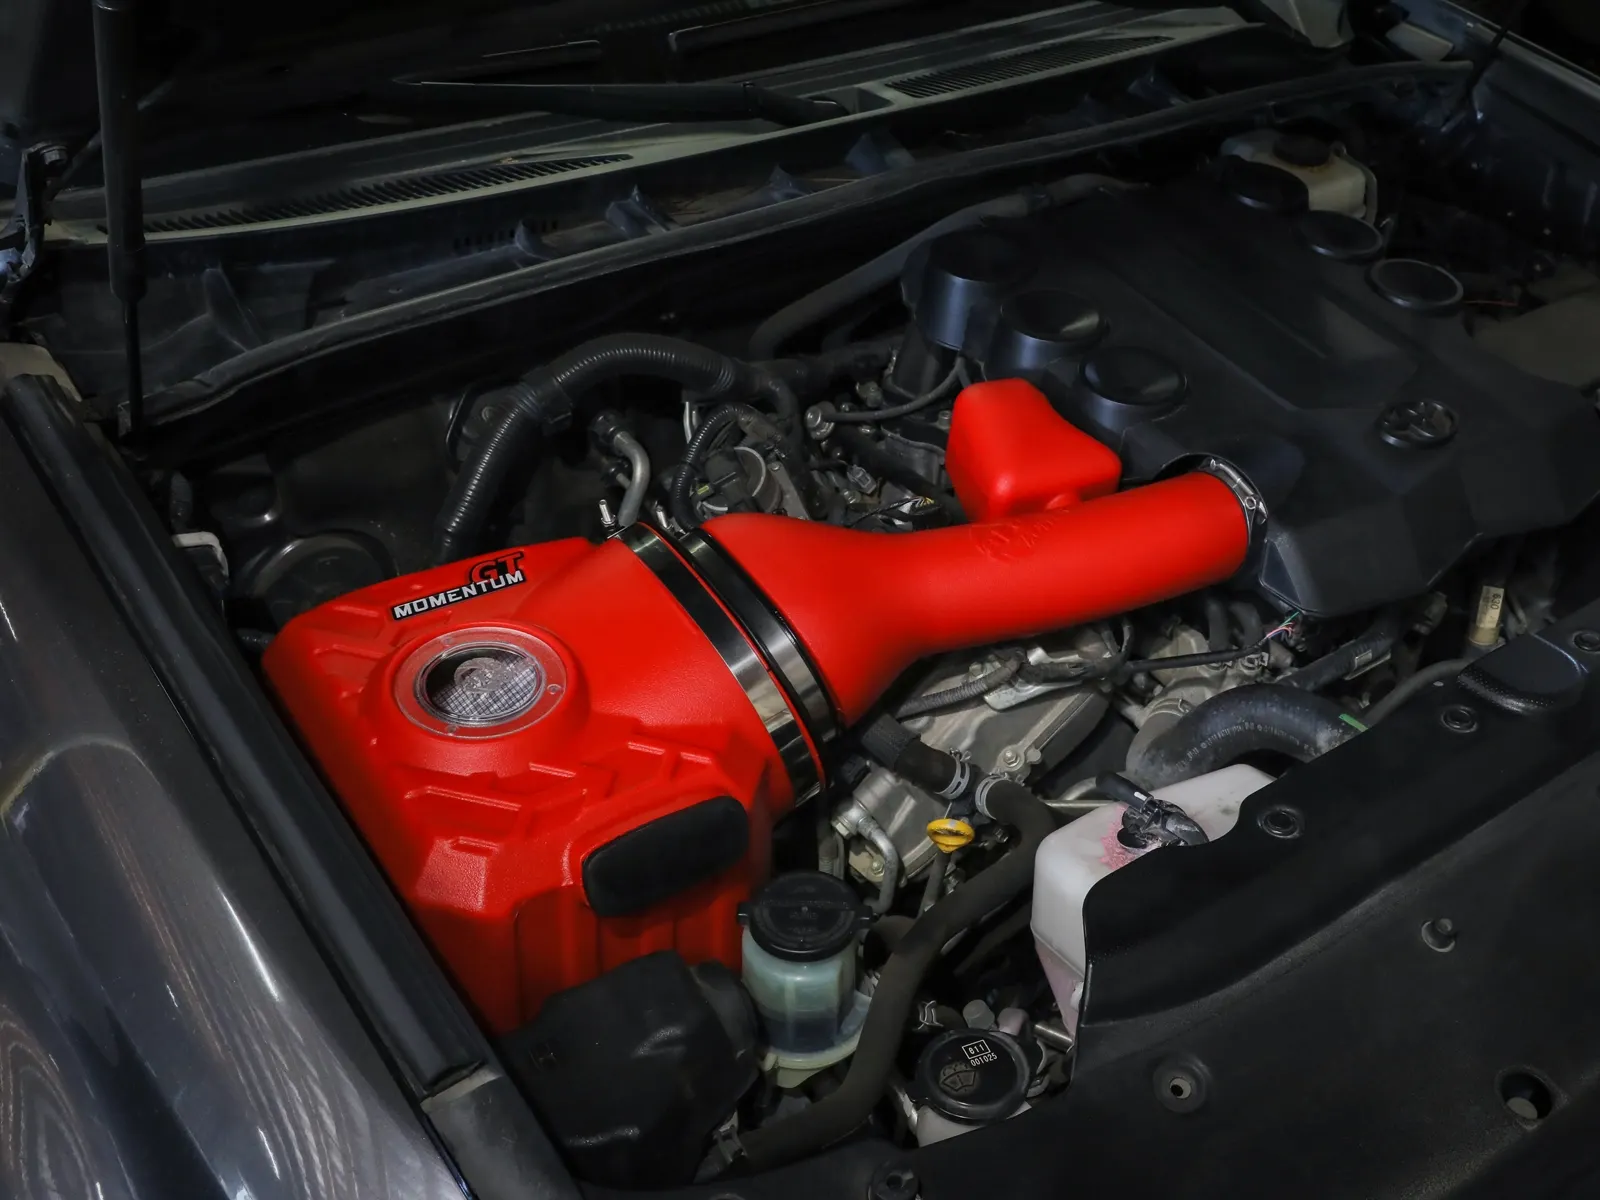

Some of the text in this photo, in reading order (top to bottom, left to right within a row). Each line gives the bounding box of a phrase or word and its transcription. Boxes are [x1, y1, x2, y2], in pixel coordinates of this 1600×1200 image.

[469, 551, 525, 583] GT
[392, 570, 524, 619] MOMENTUM
[970, 1052, 998, 1067] 001025
